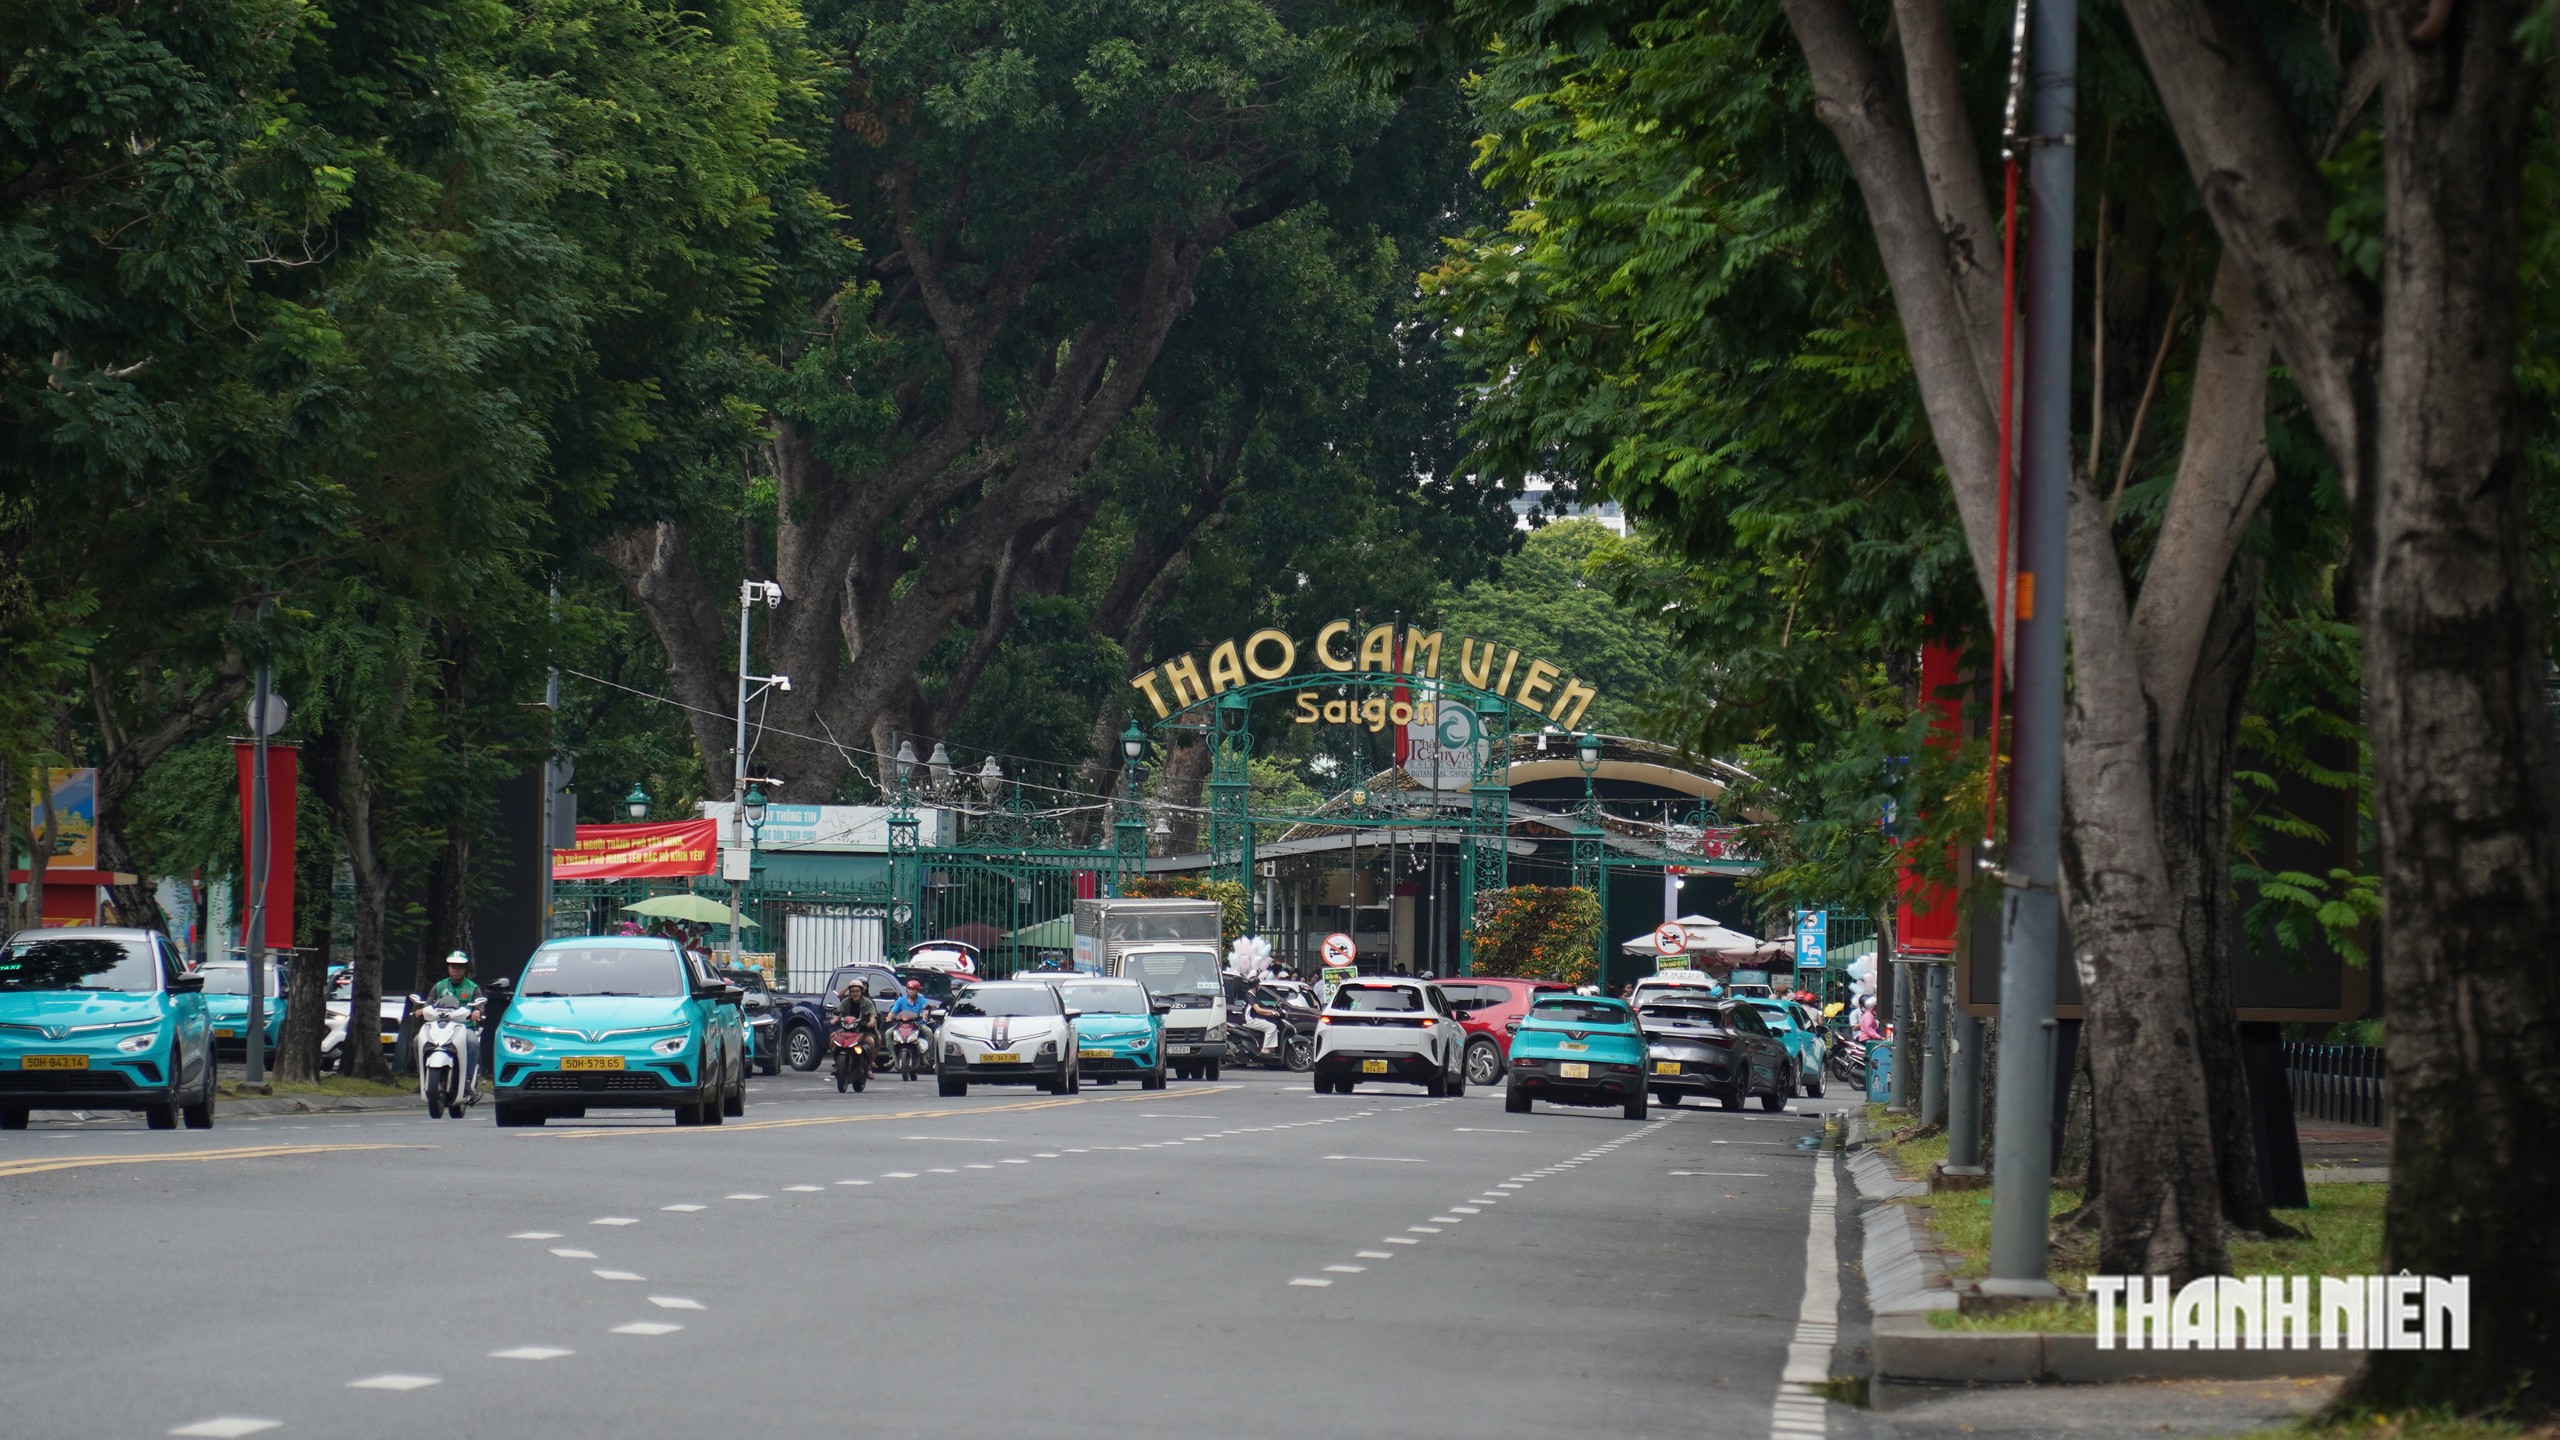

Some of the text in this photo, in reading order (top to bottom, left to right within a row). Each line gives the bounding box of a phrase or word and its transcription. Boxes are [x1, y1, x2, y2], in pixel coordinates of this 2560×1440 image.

[1129, 626, 1298, 720] THAO
[1315, 618, 1443, 680] CAM
[1296, 692, 1436, 733] Saigon
[804, 811, 817, 823] TIN
[1802, 935, 1815, 953] P
[27, 1057, 84, 1068] 50H-843.14
[566, 1058, 620, 1069] 50H-579.65
